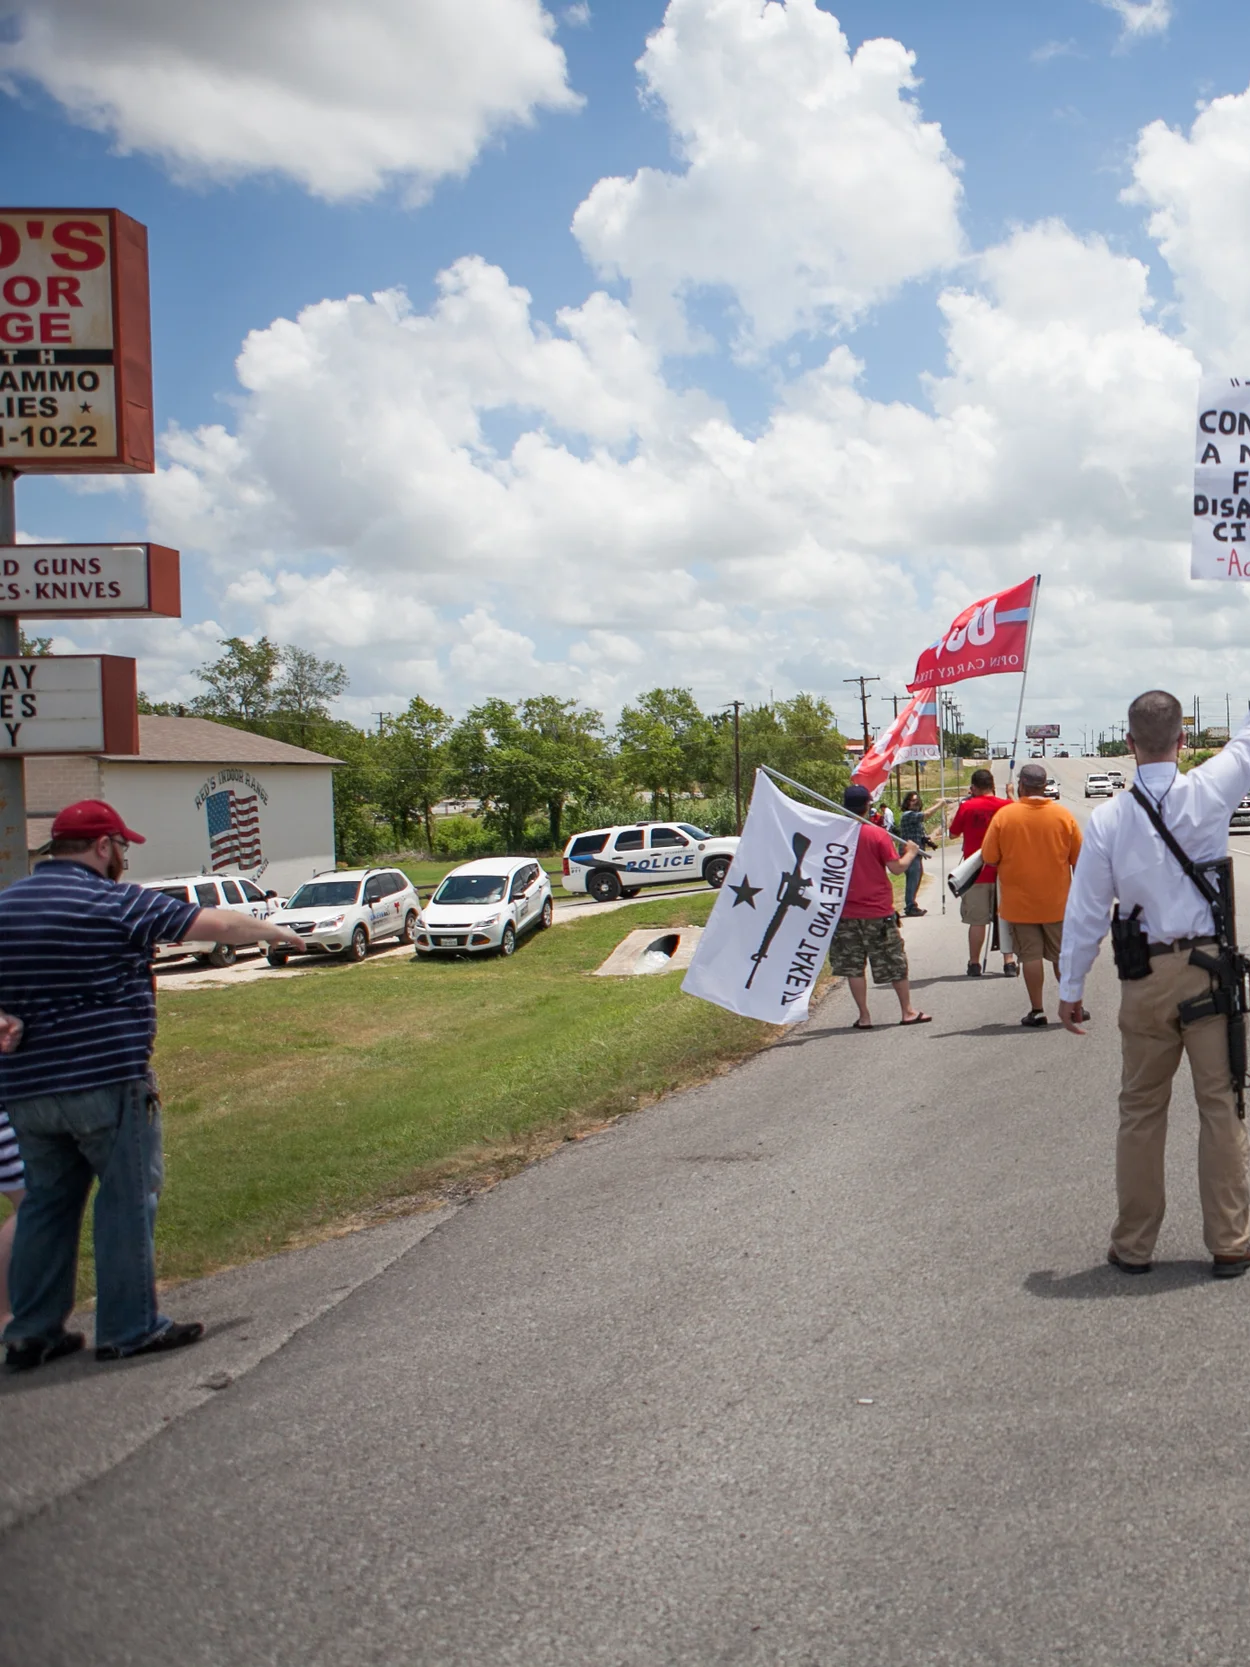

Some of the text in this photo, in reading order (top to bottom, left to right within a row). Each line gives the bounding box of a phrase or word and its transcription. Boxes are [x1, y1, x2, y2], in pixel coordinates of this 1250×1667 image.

[3, 275, 84, 307] OR
[0, 371, 100, 392] AMMO
[0, 396, 59, 418] IES
[1200, 443, 1221, 464] A
[34, 557, 102, 575] GUNS
[1, 664, 37, 690] AY
[0, 693, 37, 718] ES
[4, 722, 22, 747] Y
[626, 854, 695, 872] POLICE
